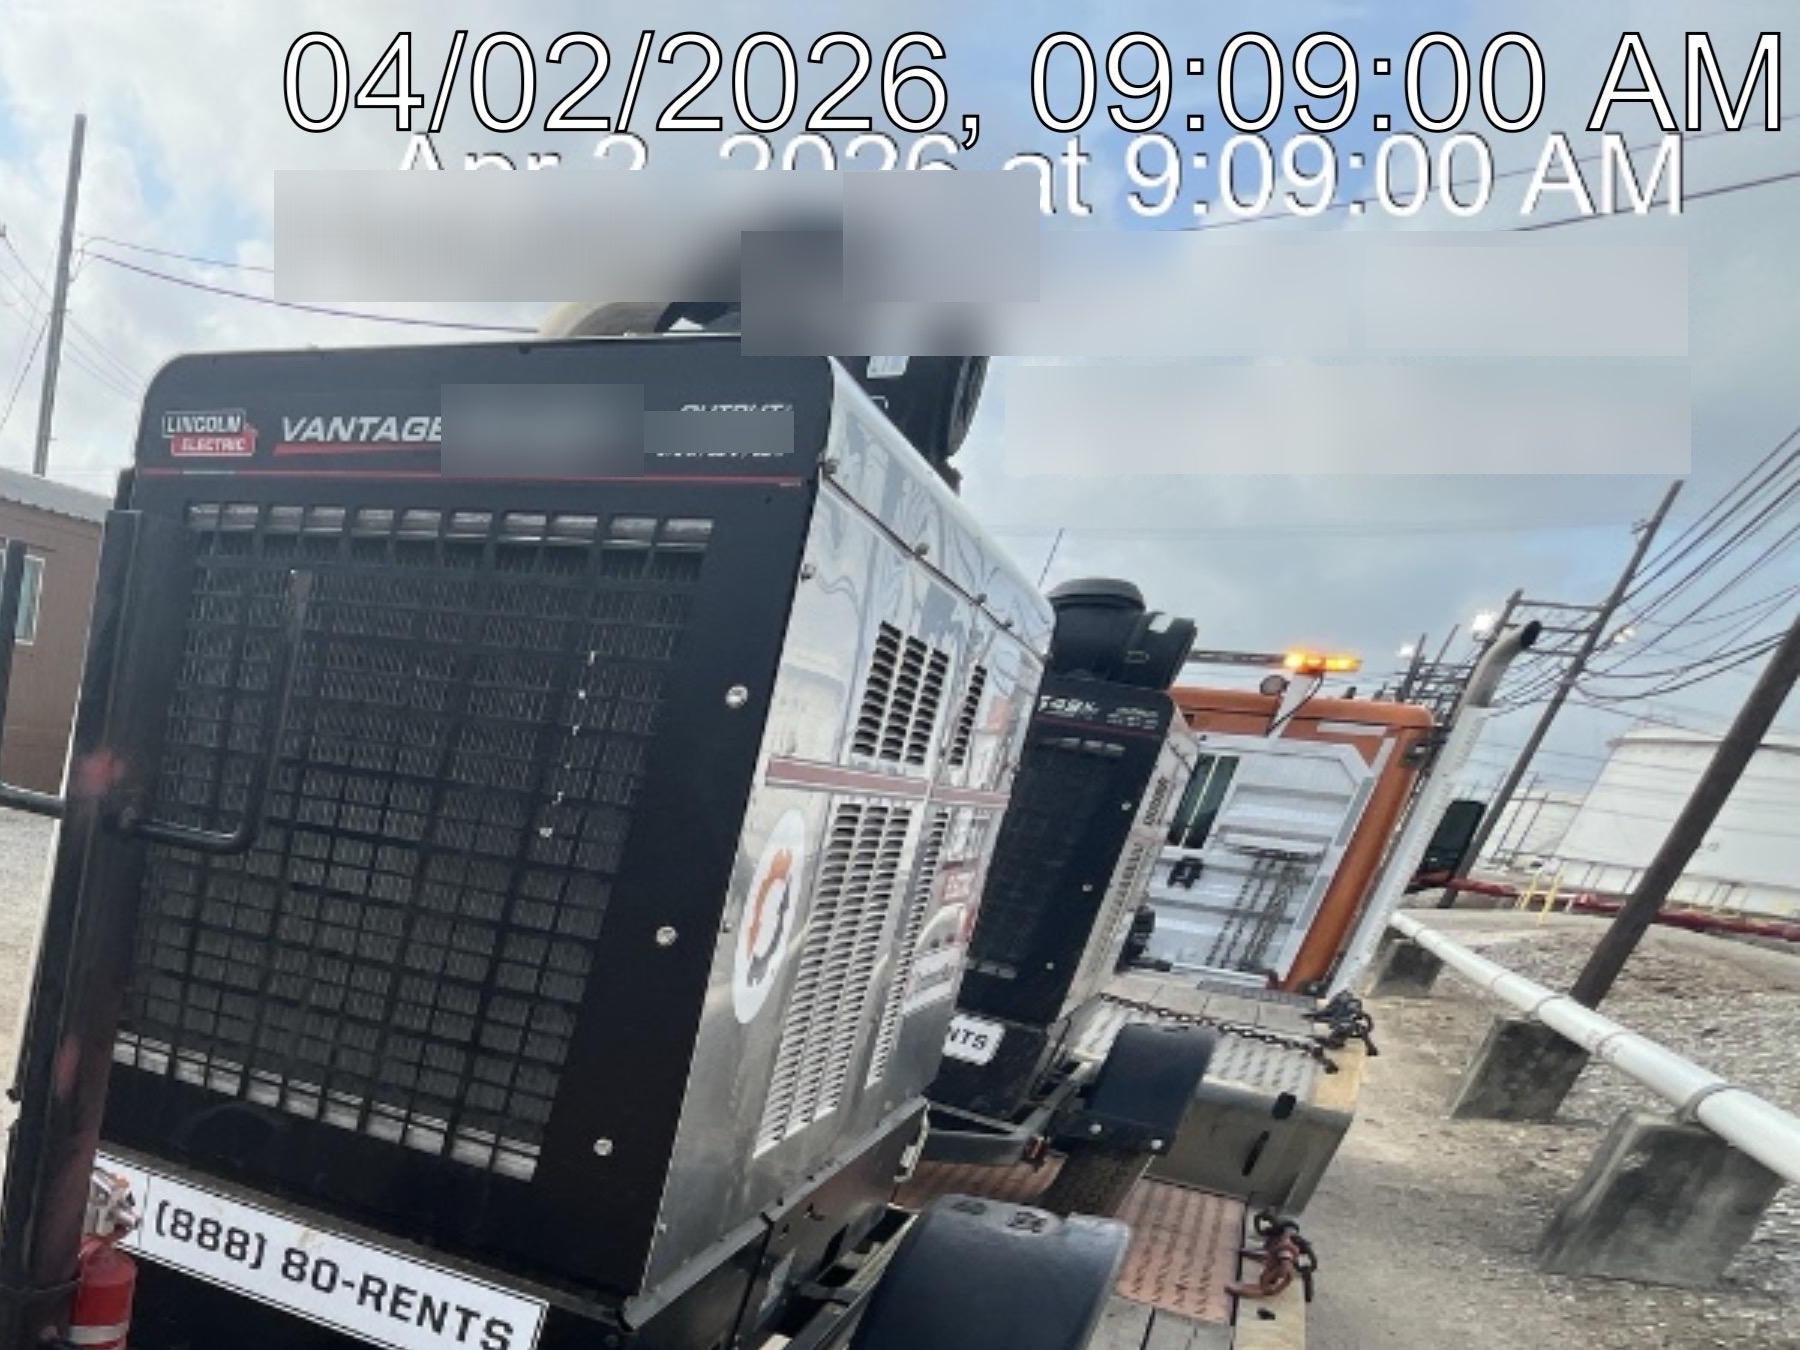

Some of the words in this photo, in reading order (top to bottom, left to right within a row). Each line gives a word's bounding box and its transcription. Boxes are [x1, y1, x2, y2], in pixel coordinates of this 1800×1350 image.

[166, 414, 242, 434] LINCOLN
[181, 436, 248, 452] ELECTRIC
[156, 1200, 267, 1270] (888)
